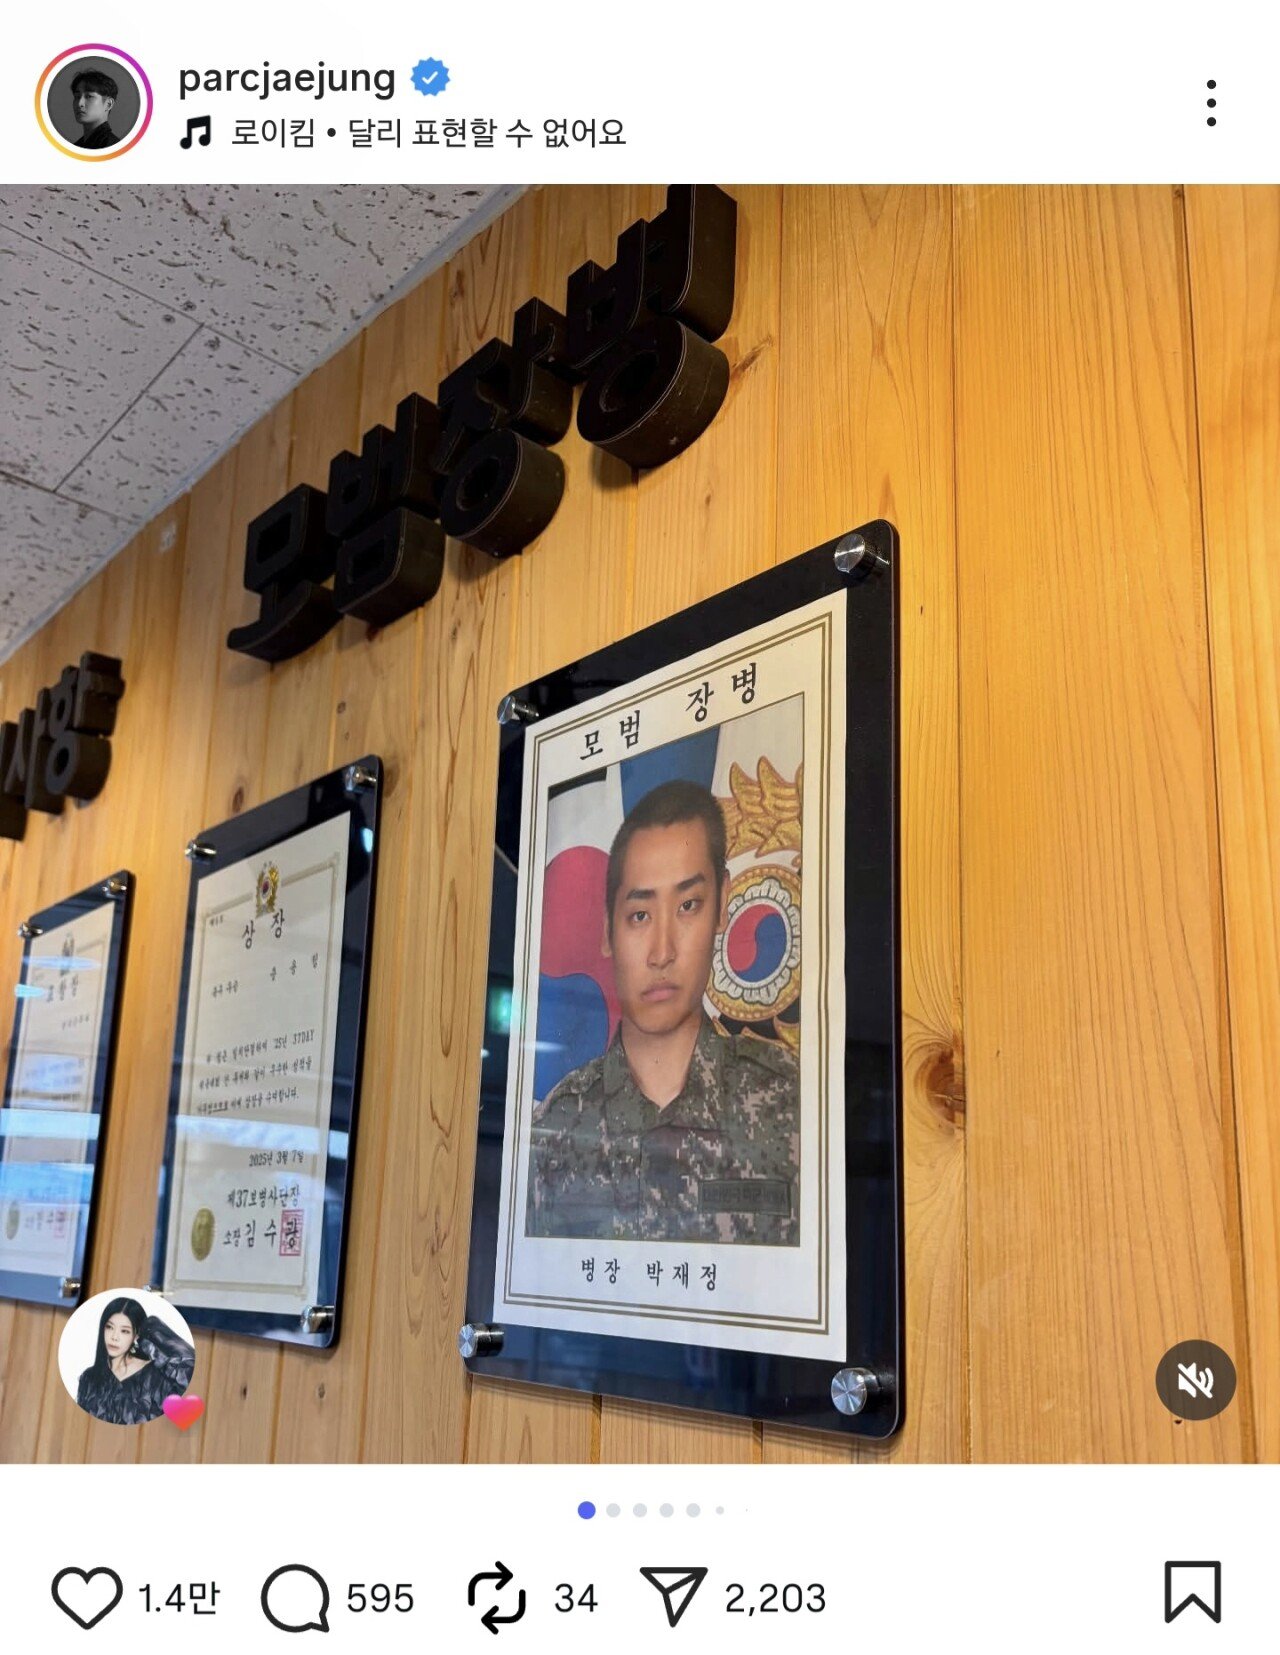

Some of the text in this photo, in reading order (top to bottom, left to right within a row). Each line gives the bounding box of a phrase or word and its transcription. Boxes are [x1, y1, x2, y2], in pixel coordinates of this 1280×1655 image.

[579, 662, 758, 761] 모범 장병
[249, 1150, 273, 1168] 2025년
[227, 1184, 300, 1209] 제37보병사단장
[581, 1257, 717, 1292] 병장 박재정
